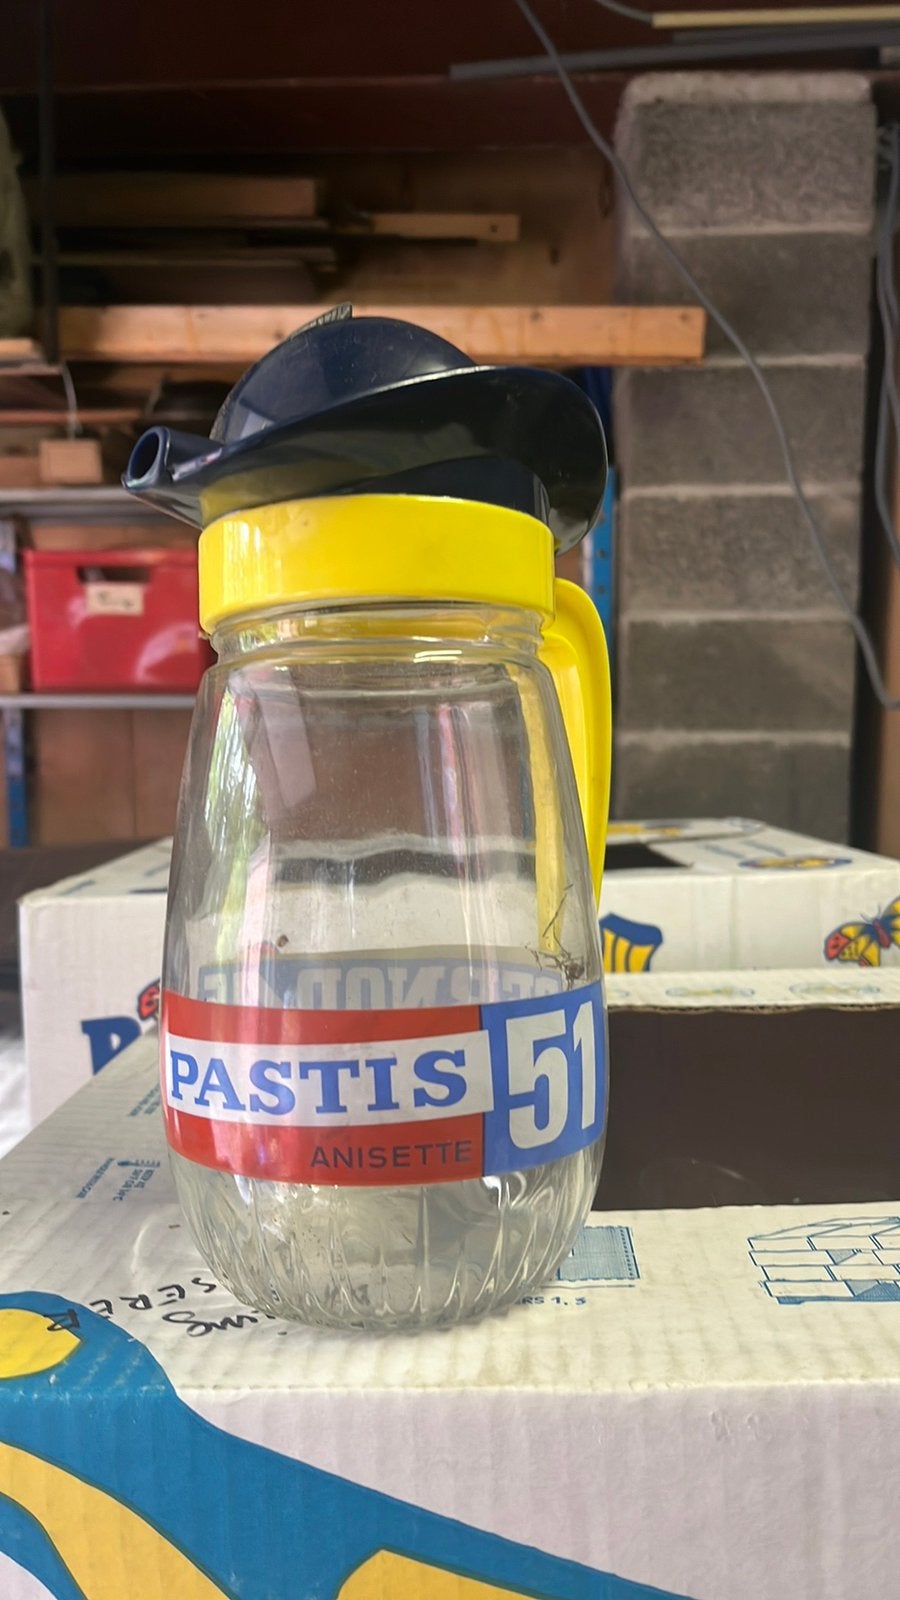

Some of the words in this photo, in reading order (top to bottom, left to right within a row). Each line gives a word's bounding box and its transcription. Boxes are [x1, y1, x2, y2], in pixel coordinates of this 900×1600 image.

[170, 1049, 468, 1116] PASTIS
[505, 1000, 597, 1150] 51
[310, 1139, 472, 1169] ANISETTE
